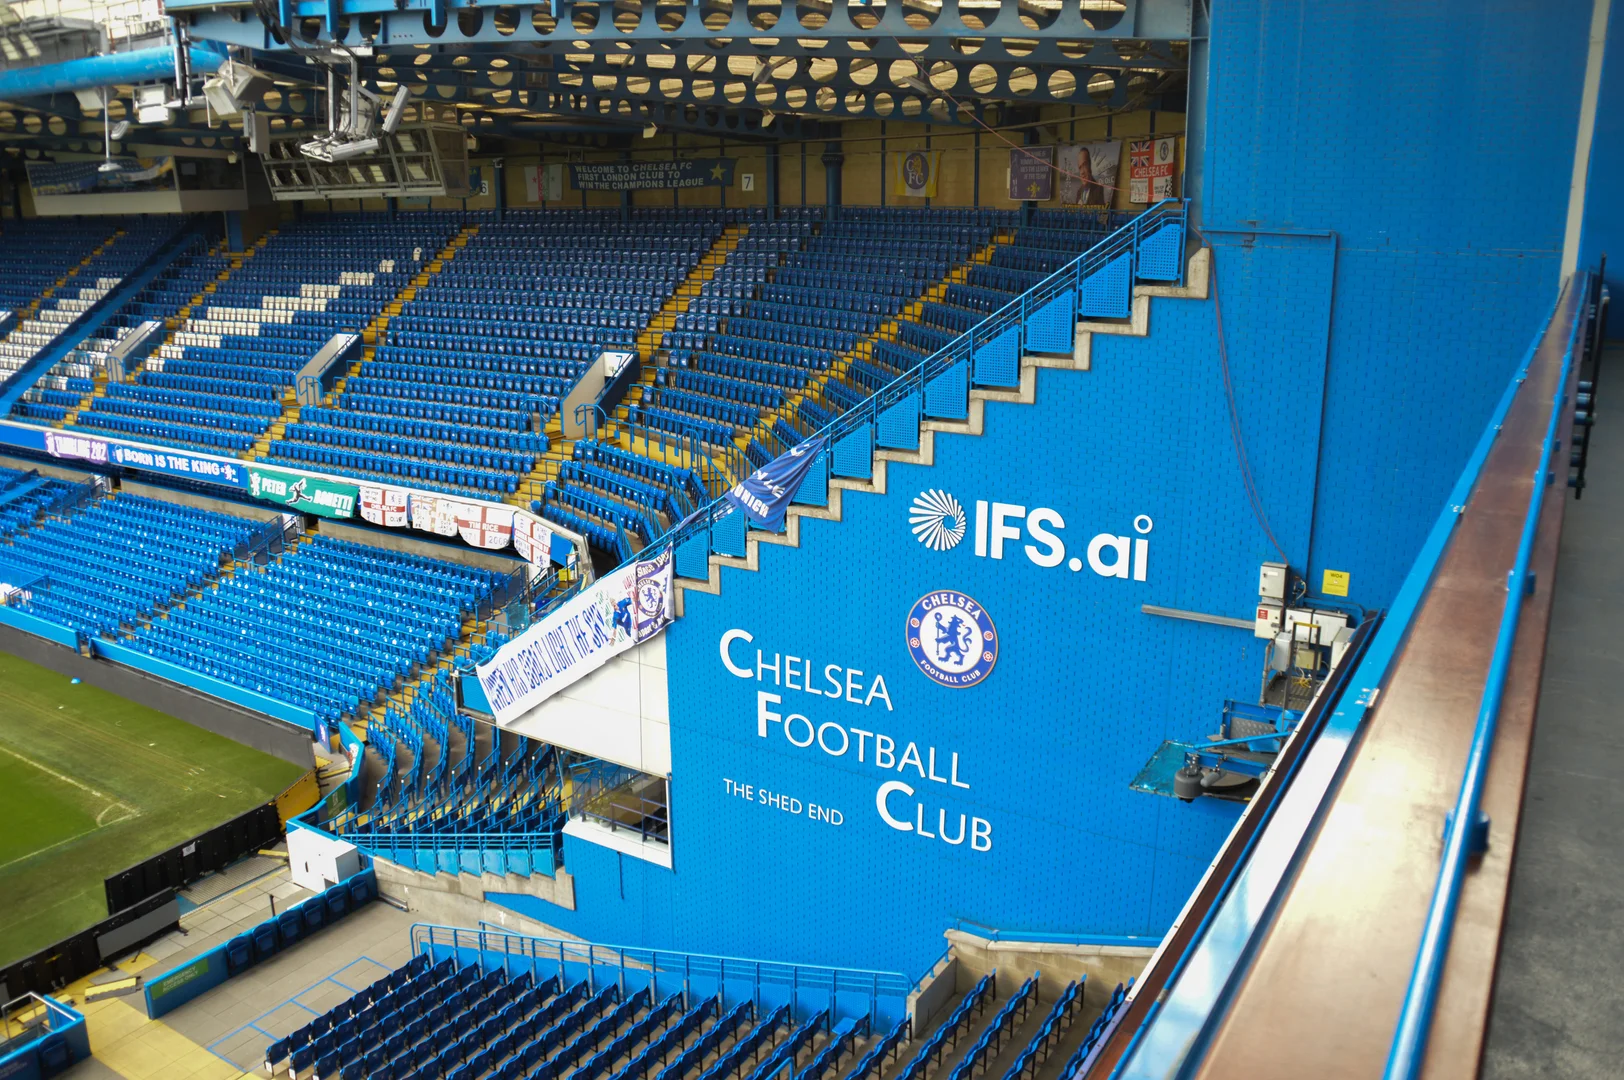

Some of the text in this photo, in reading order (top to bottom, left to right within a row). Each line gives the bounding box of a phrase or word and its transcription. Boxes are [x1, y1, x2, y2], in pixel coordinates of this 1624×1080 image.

[575, 162, 693, 174] WELCOME TO CHELSEA FC
[577, 170, 680, 182] FIRST LONDON CLUB TO
[1134, 165, 1169, 178] CHELSEA FC
[578, 178, 704, 190] WIN THE CHAMPIONS LEAGUE
[744, 176, 752, 190] 7
[124, 449, 220, 475] BORN IS THE KING
[262, 478, 286, 496] PETER
[313, 489, 353, 511] BONETTI
[469, 521, 499, 532] TIM RICE
[489, 535, 509, 547] 2008
[975, 500, 1153, 582] IFS.ai
[921, 592, 982, 621] CHELSEA
[540, 625, 577, 674] LIGHT
[565, 614, 594, 659] THE
[719, 628, 894, 712] CHELSEA
[920, 659, 981, 684] FOOTBALL CLUB
[757, 690, 970, 790] FOOTBALL
[723, 777, 844, 826] THE SHED END
[875, 780, 992, 852] CLUB
[163, 965, 196, 986] EMERGENCY
